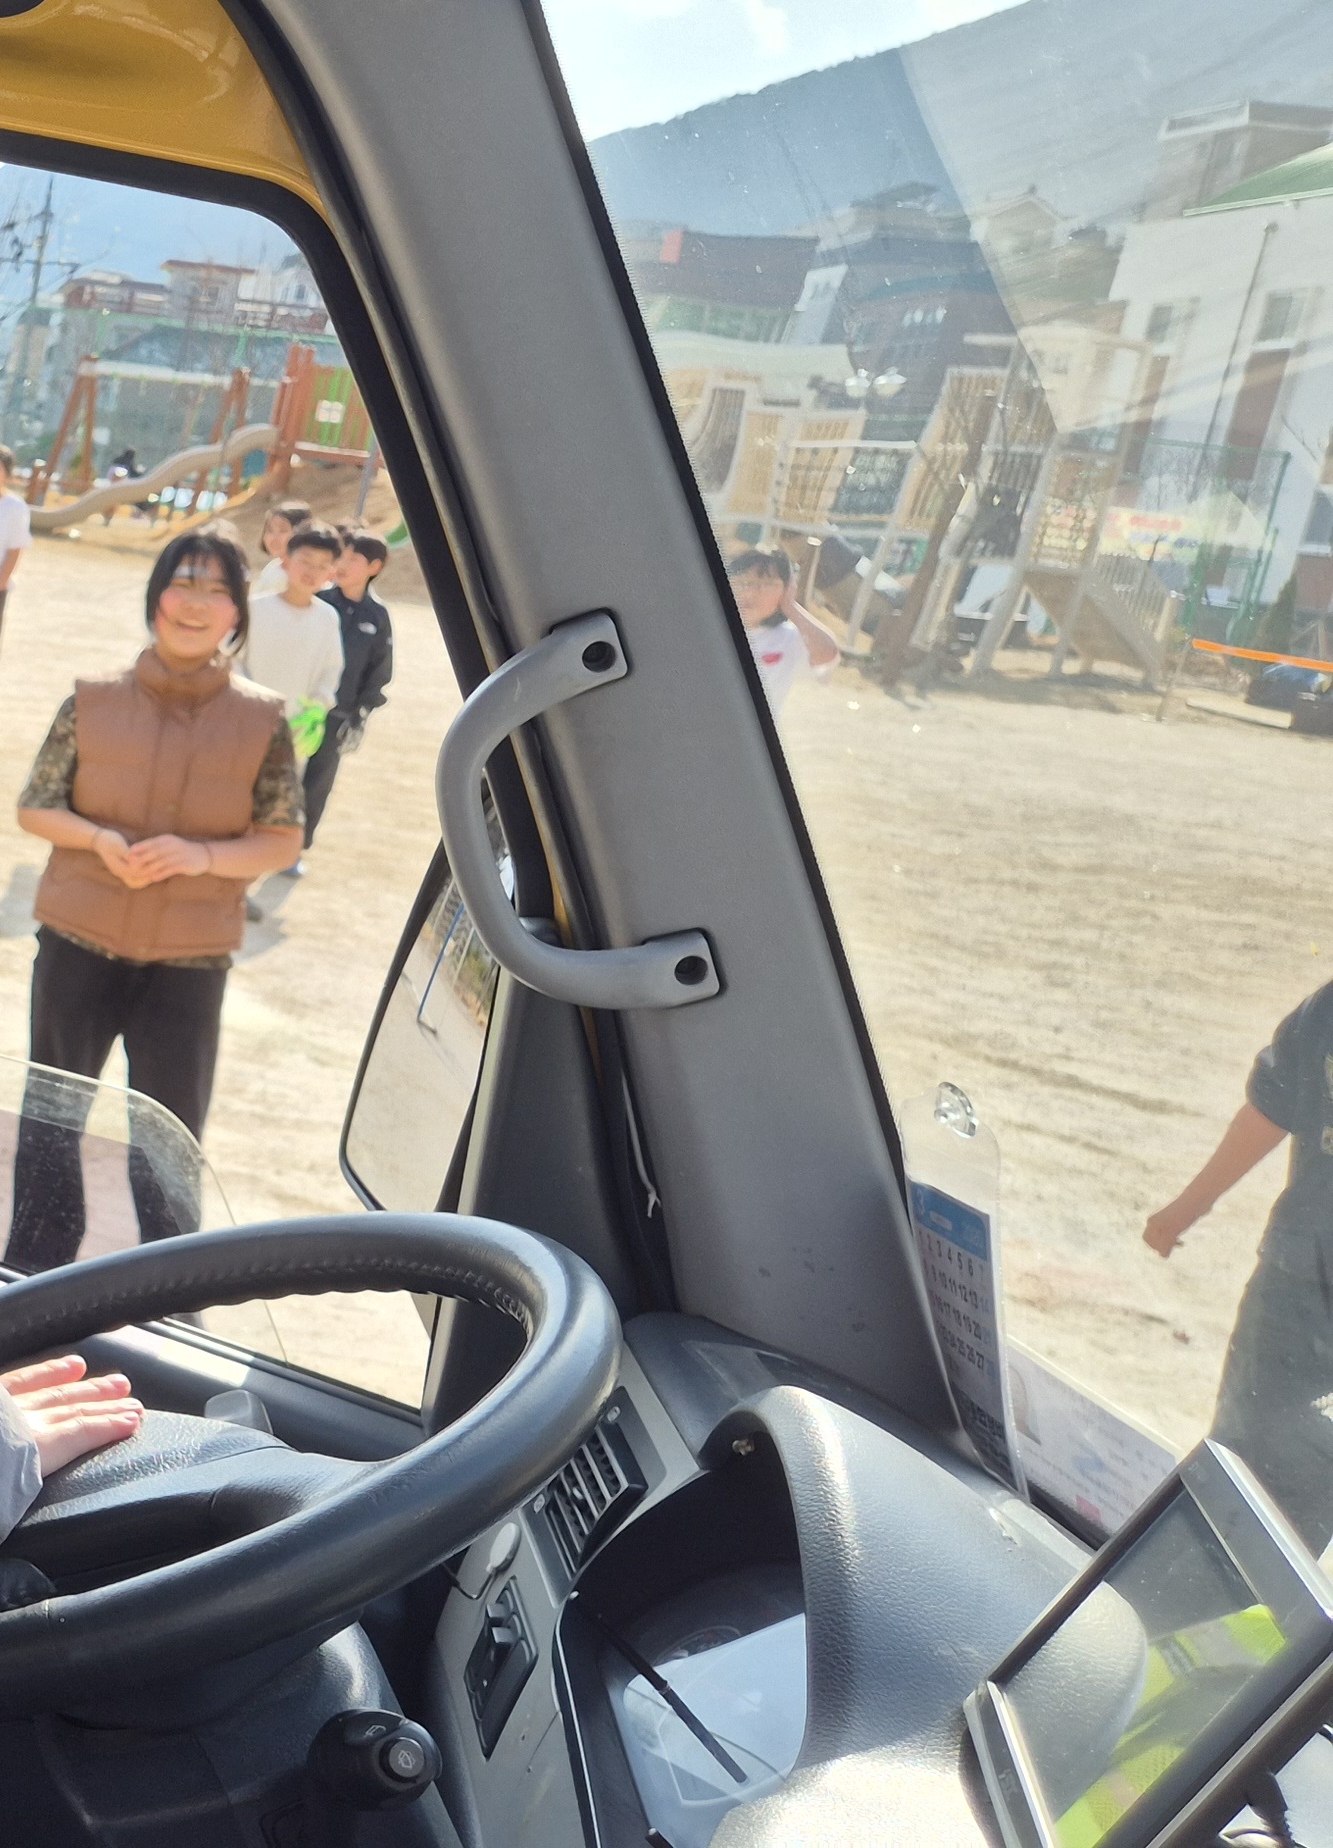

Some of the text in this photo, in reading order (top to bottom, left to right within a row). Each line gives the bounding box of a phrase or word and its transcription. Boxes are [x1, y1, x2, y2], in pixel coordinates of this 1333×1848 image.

[936, 1240, 943, 1258] 3
[947, 1246, 953, 1264] 4
[957, 1251, 964, 1270] 5
[967, 1257, 974, 1277] 6
[948, 1277, 958, 1296] 11
[958, 1284, 968, 1303] 12
[968, 1290, 979, 1310] 13
[972, 1320, 982, 1341] 20
[975, 1350, 986, 1371] 27
